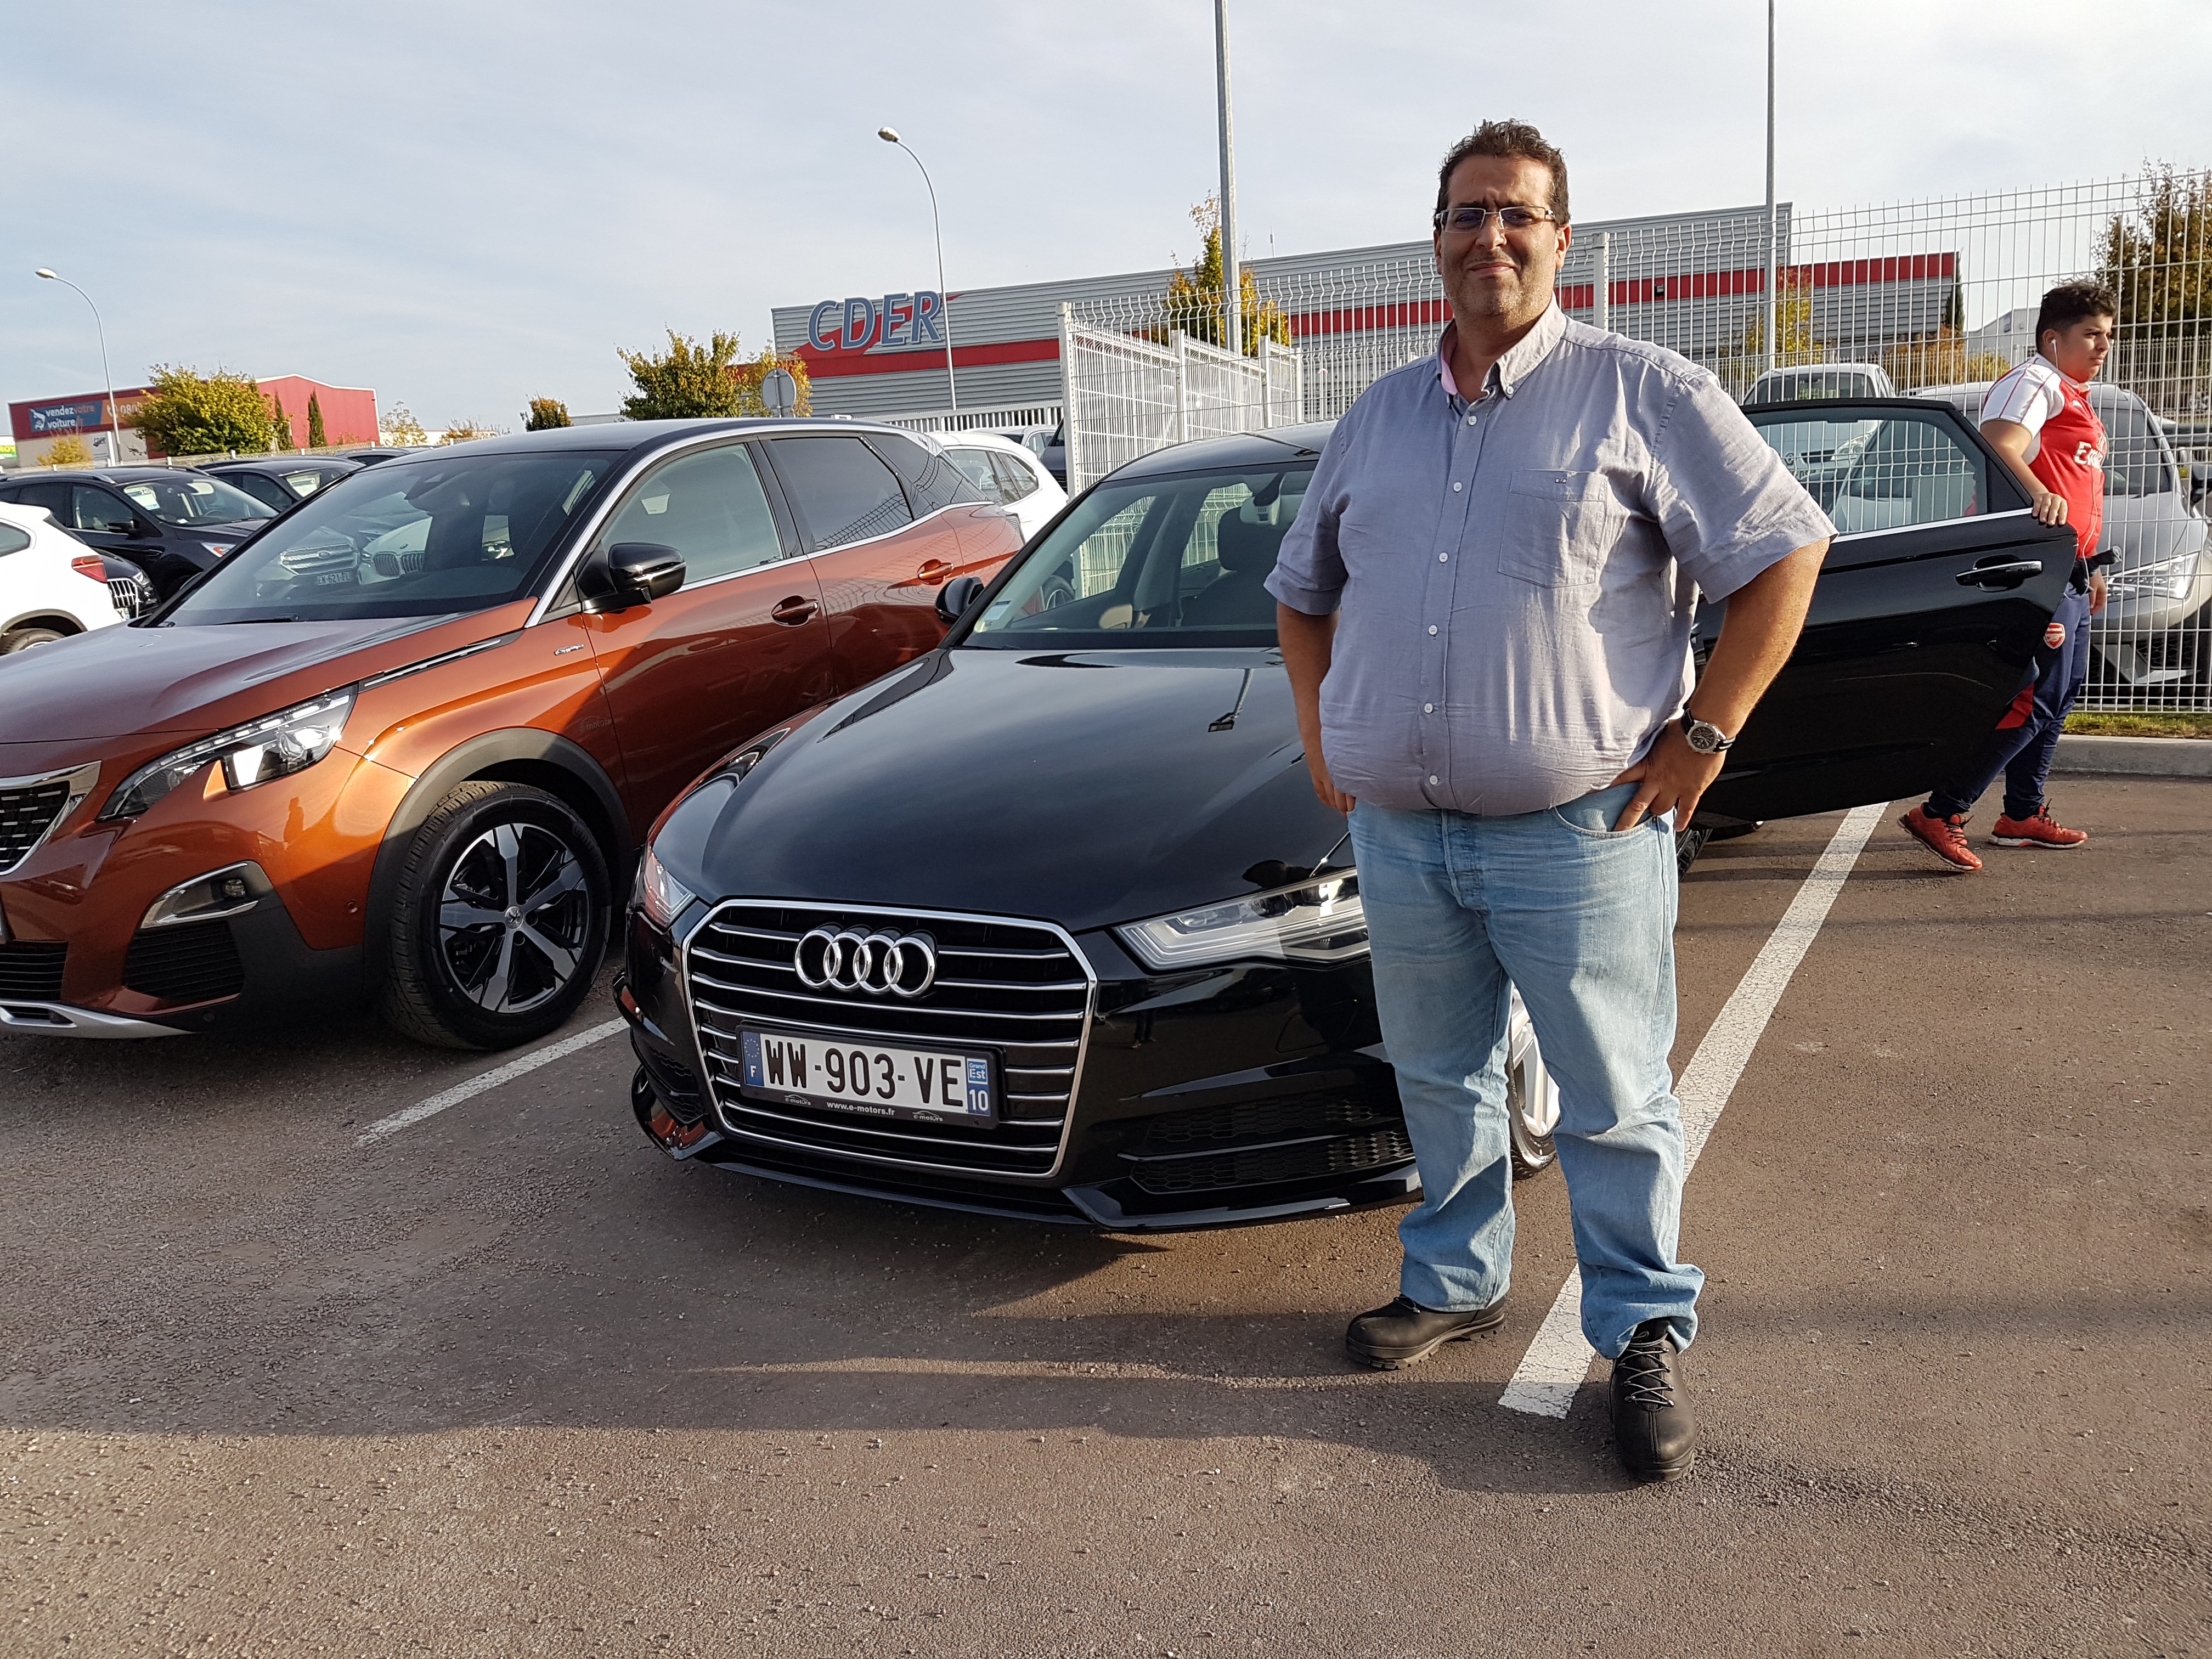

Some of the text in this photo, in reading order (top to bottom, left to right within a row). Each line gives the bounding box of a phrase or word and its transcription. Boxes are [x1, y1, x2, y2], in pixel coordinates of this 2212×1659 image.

[808, 291, 943, 351] CDER
[45, 405, 75, 417] vendez
[751, 1065, 757, 1077] F
[765, 1039, 963, 1107] WW-903-VE
[969, 1069, 986, 1080] Est
[969, 1089, 989, 1111] 10
[827, 1102, 895, 1116] www.e-motors.fr
